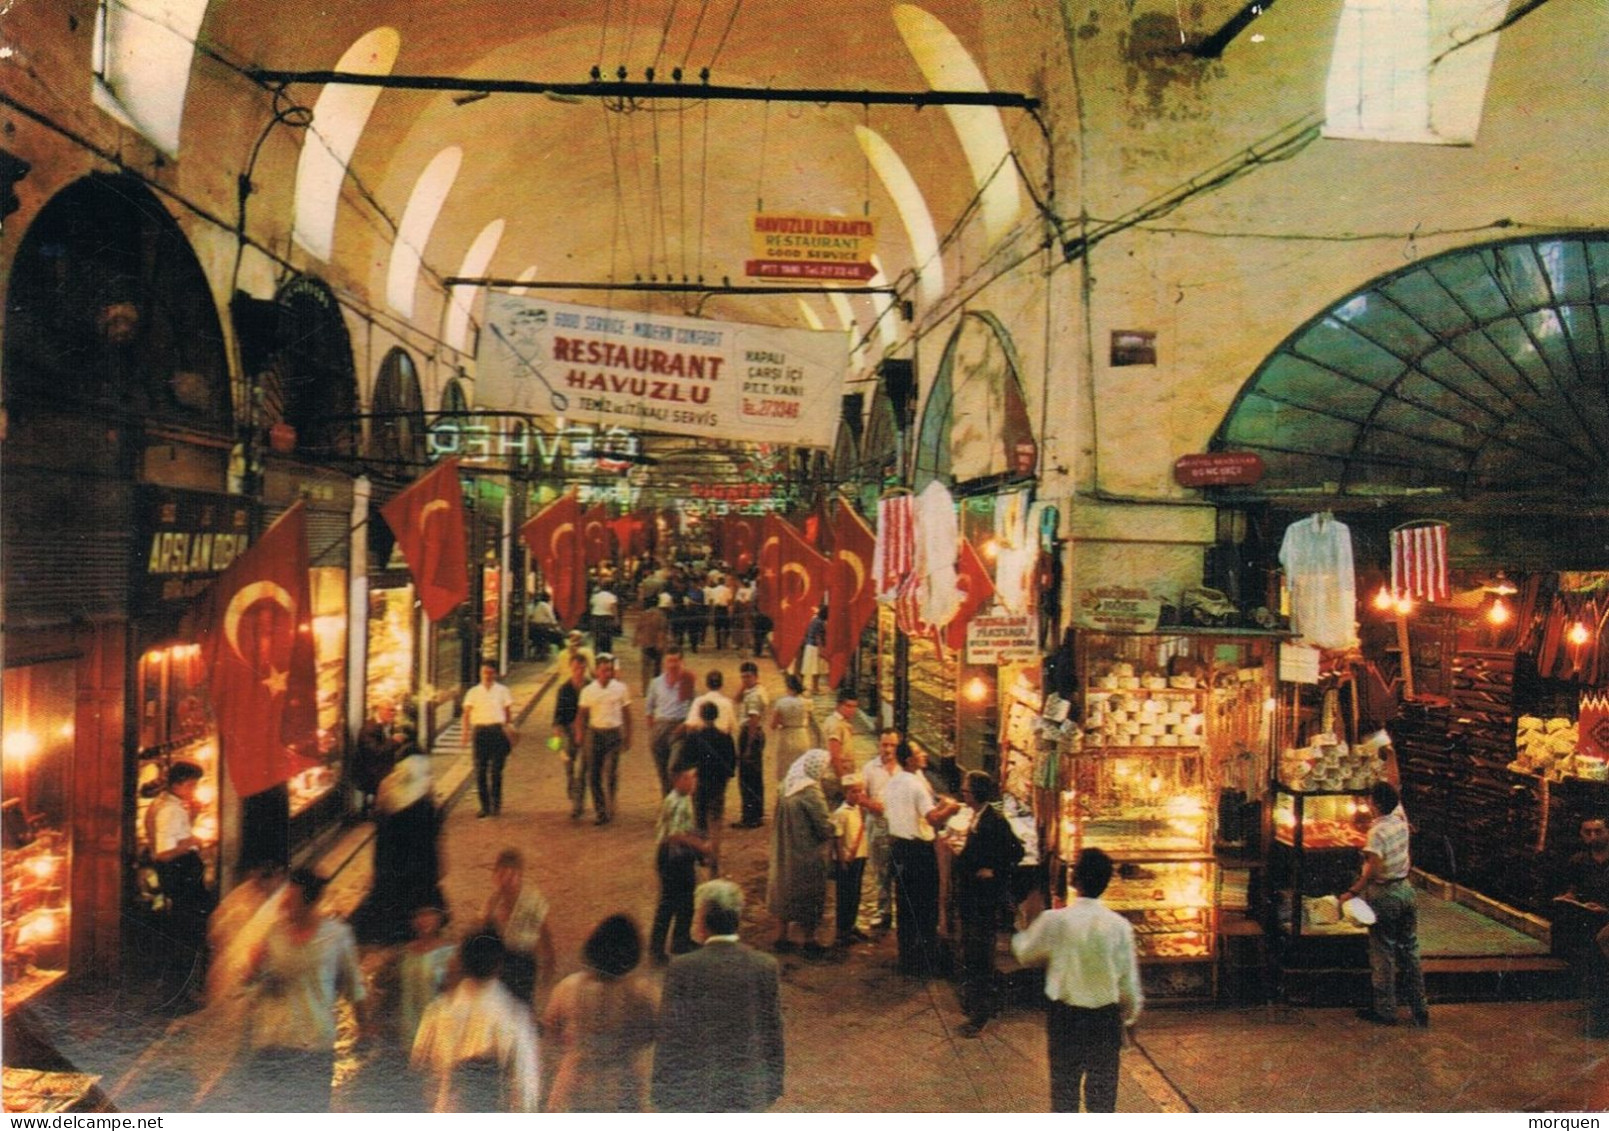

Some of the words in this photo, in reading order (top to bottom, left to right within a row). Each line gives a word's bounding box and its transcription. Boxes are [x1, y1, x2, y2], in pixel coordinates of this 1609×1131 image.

[755, 217, 813, 234] HAVUZLU
[765, 235, 860, 250] RESTAURANT
[767, 248, 801, 258] GOOD
[807, 249, 859, 261] SERVICE
[554, 312, 581, 330] GOOD
[584, 315, 625, 335] SERVICE
[633, 322, 673, 342] MODERN
[553, 336, 724, 381] RESTAURANT
[745, 350, 785, 365] KAPALI
[565, 369, 711, 404] HAVUZLU
[148, 532, 212, 573] ARSLAN
